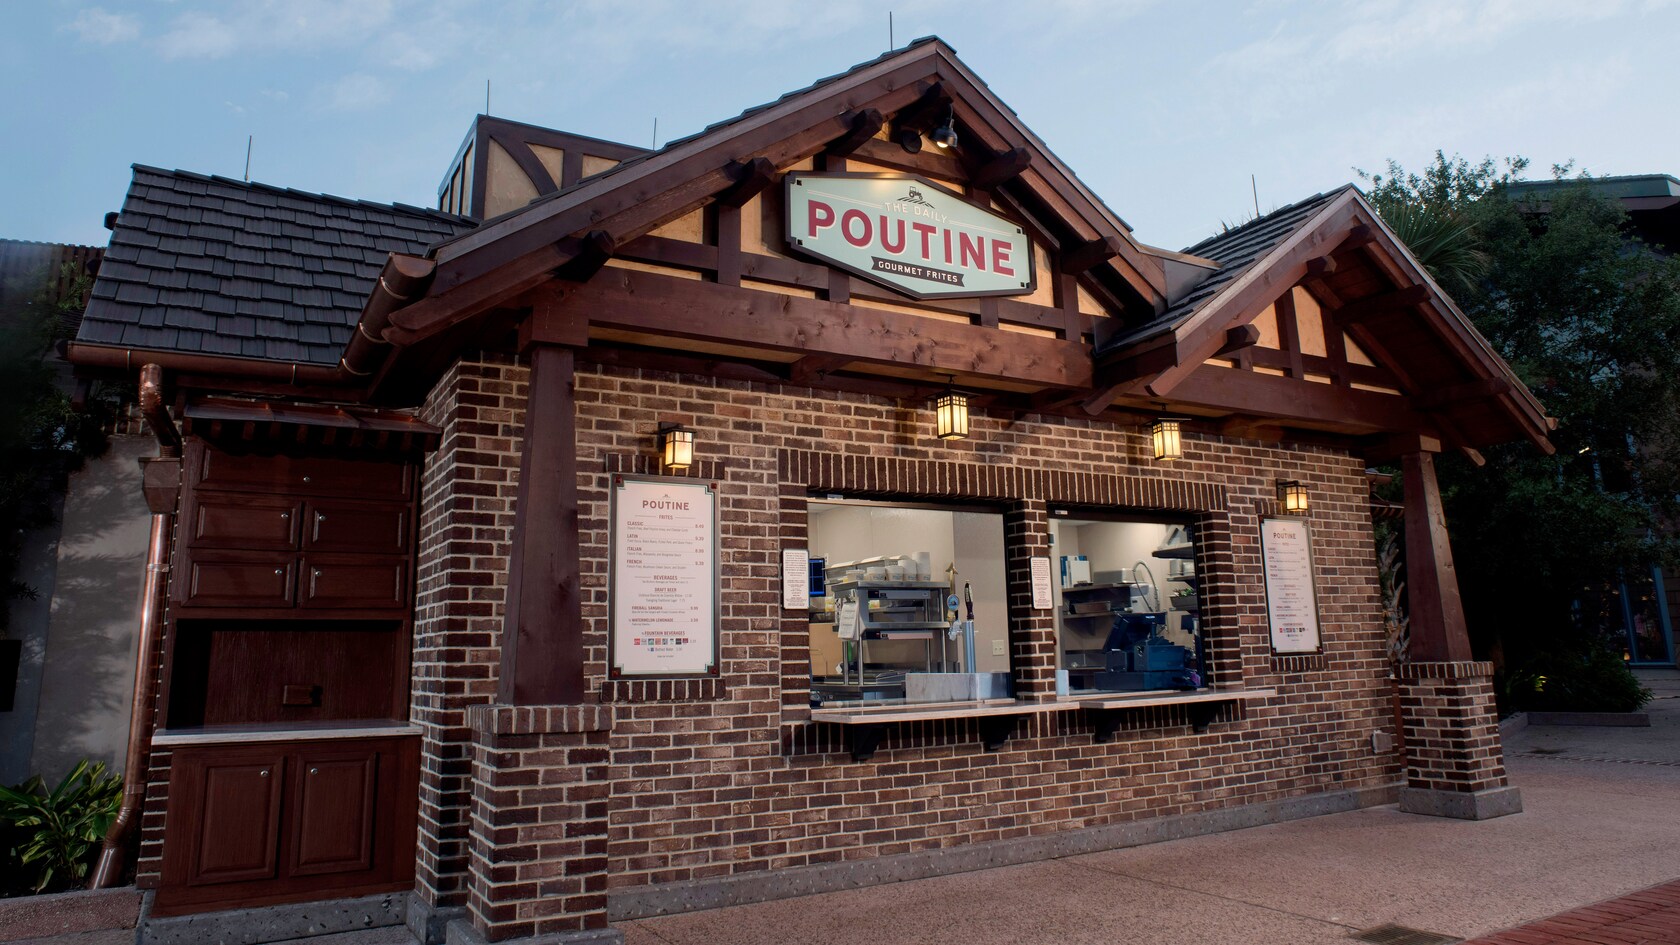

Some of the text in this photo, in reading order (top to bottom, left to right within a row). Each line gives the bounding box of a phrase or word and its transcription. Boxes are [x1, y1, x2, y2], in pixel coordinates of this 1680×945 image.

[884, 202, 948, 224] THE DAILY
[807, 199, 1016, 277] POUTINE
[878, 261, 959, 283] GOURMET FRITES
[642, 500, 690, 511] POUTINE
[1273, 532, 1297, 540] POUTINE
